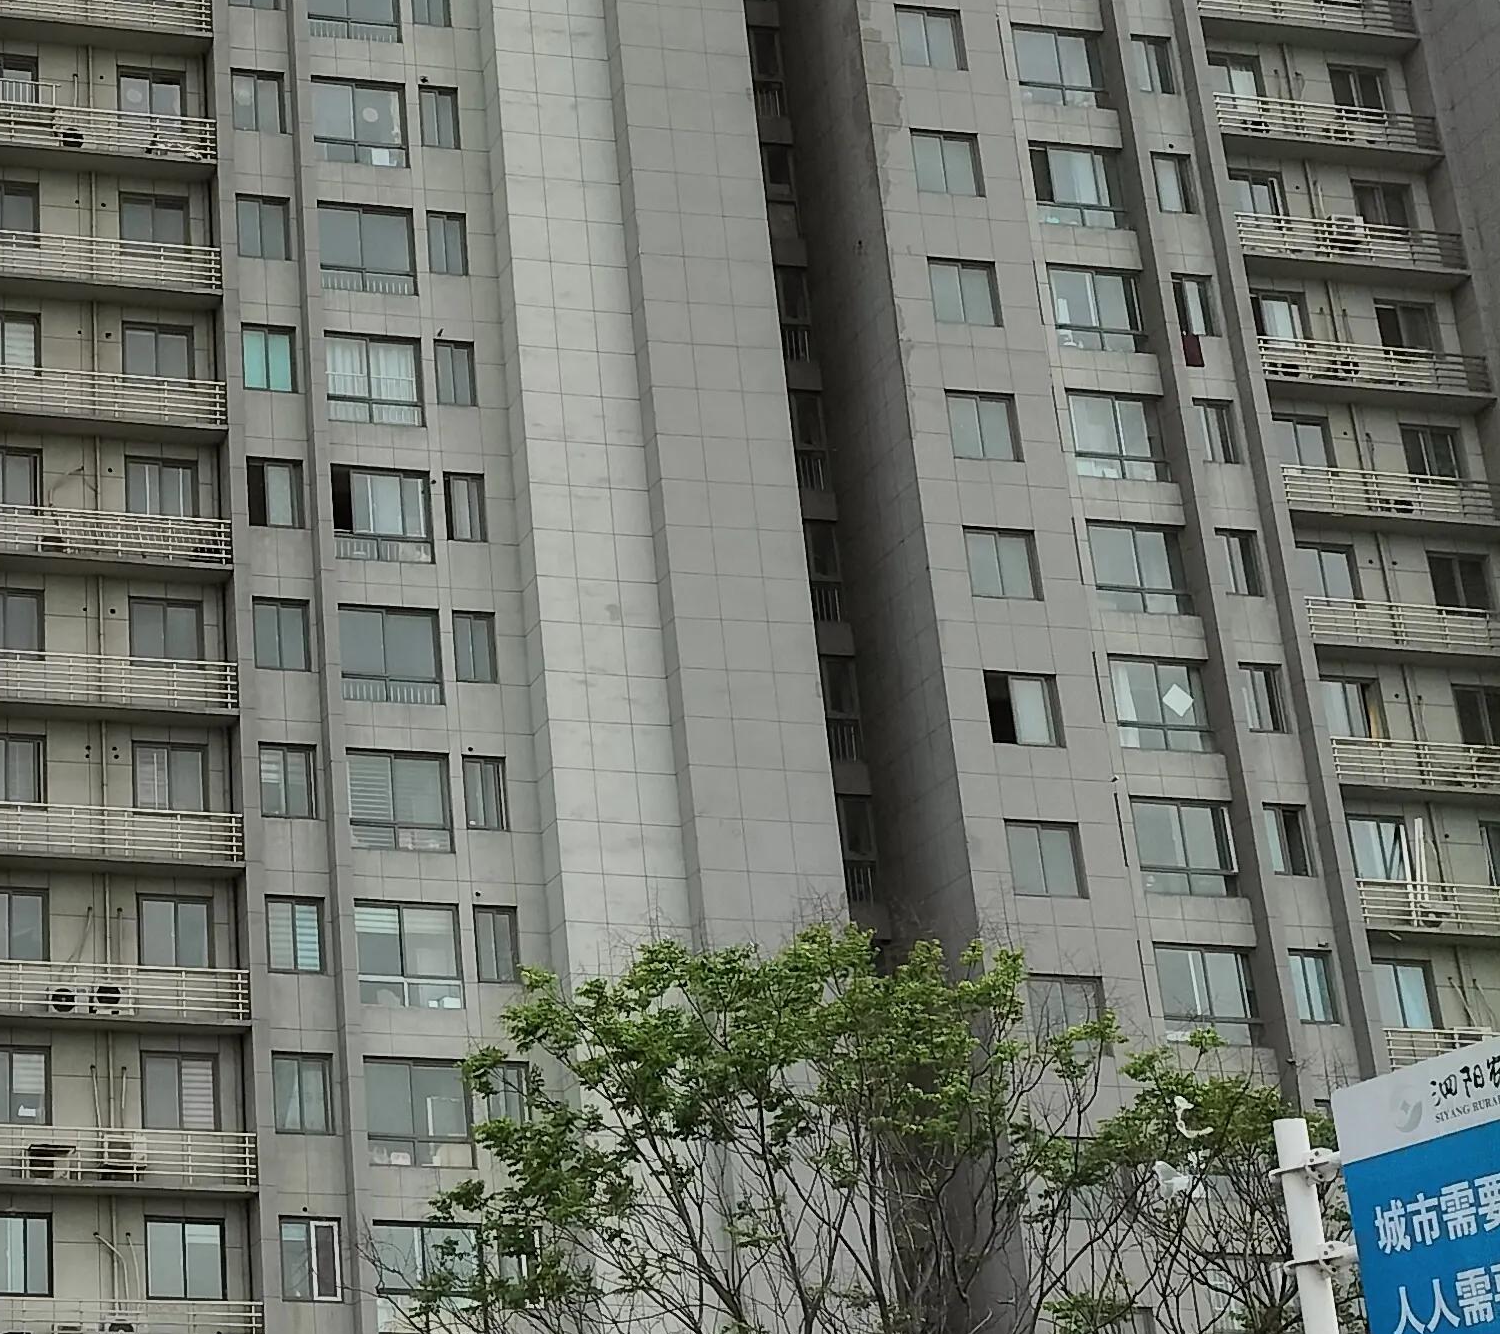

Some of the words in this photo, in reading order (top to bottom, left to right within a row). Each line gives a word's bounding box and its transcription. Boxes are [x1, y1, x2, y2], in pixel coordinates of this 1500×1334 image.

[1435, 1105, 1470, 1123] SIYANG
[1374, 1172, 1500, 1255] 城市需要
